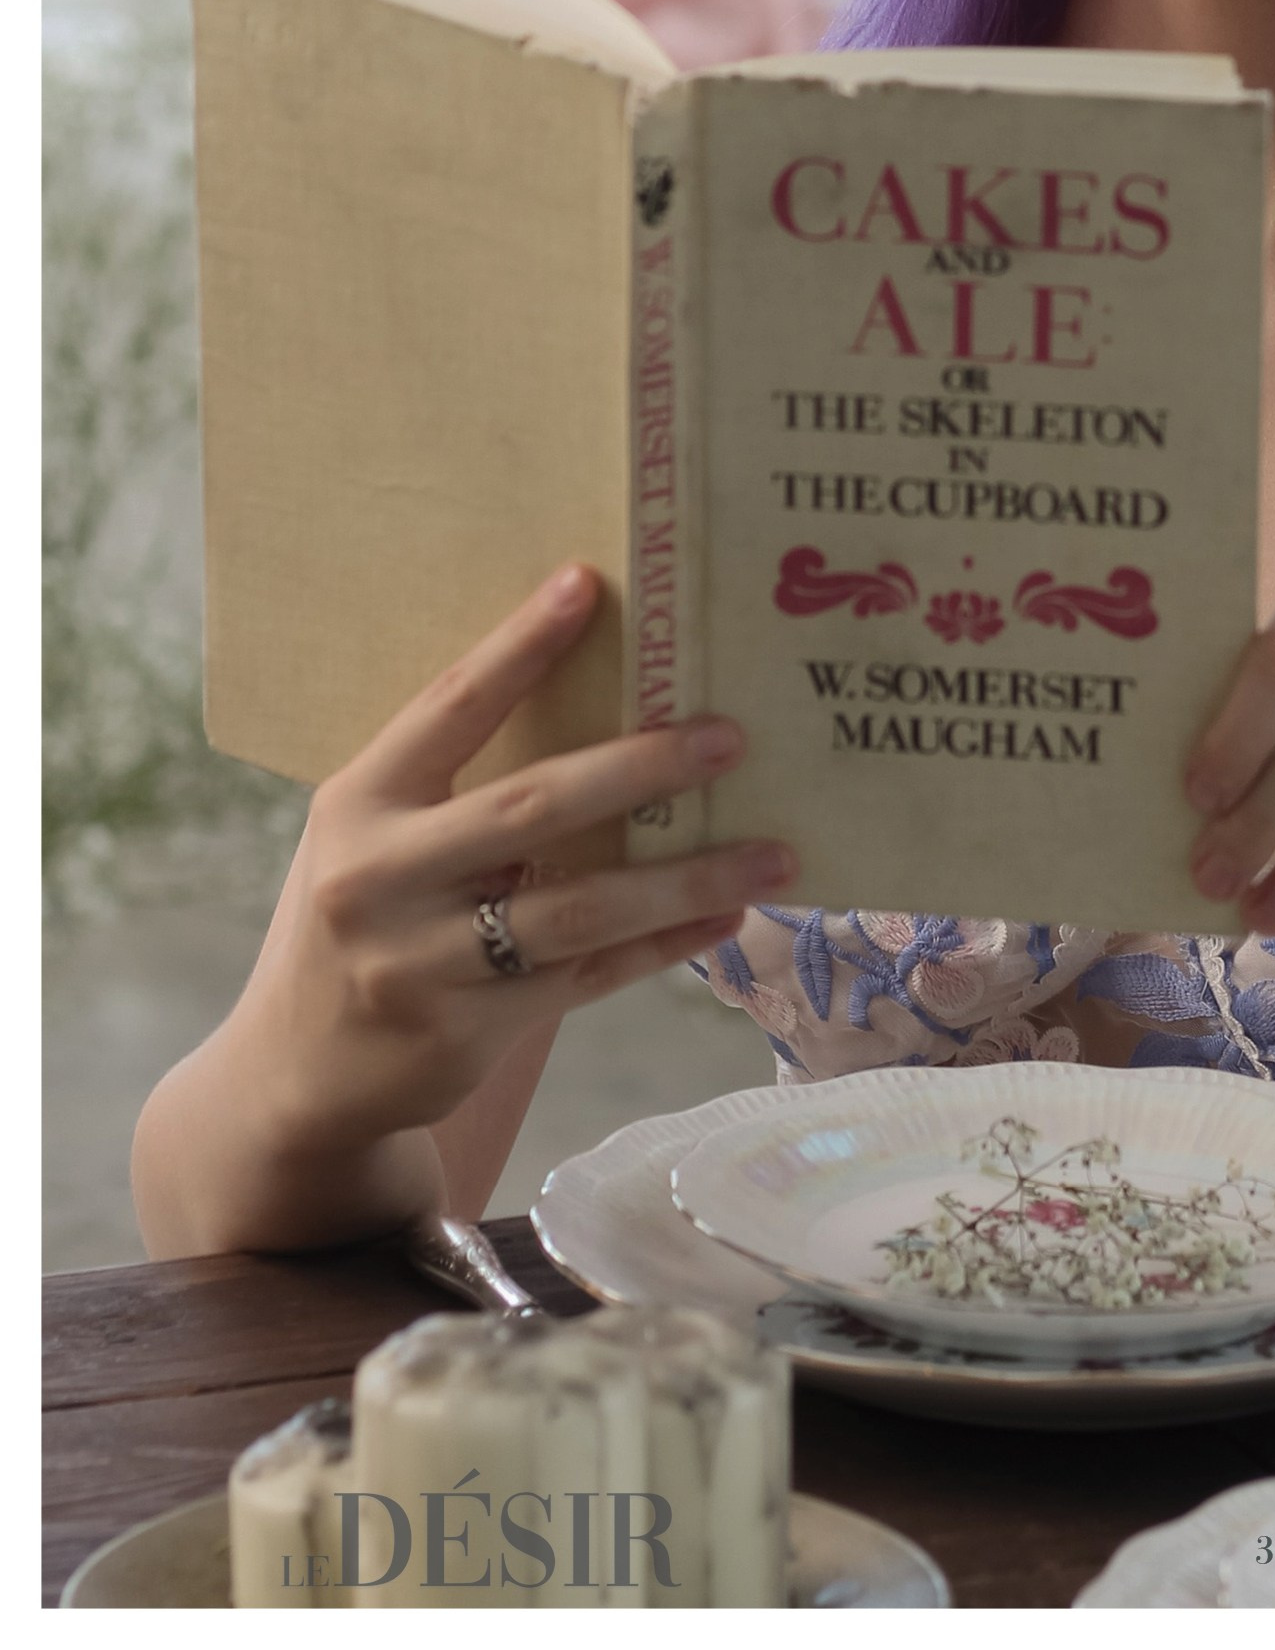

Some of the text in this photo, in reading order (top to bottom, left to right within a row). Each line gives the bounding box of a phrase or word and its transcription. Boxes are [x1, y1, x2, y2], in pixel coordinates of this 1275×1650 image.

[768, 154, 1174, 261] CAKES
[925, 249, 1010, 277] AND
[941, 366, 990, 393] OR
[770, 390, 1169, 449] THE SKELETON
[946, 446, 989, 473] IN
[770, 471, 1170, 531] THE CUPBOARD
[800, 660, 1136, 715] W. SOMERSET
[832, 712, 1100, 764] MAUGHAM
